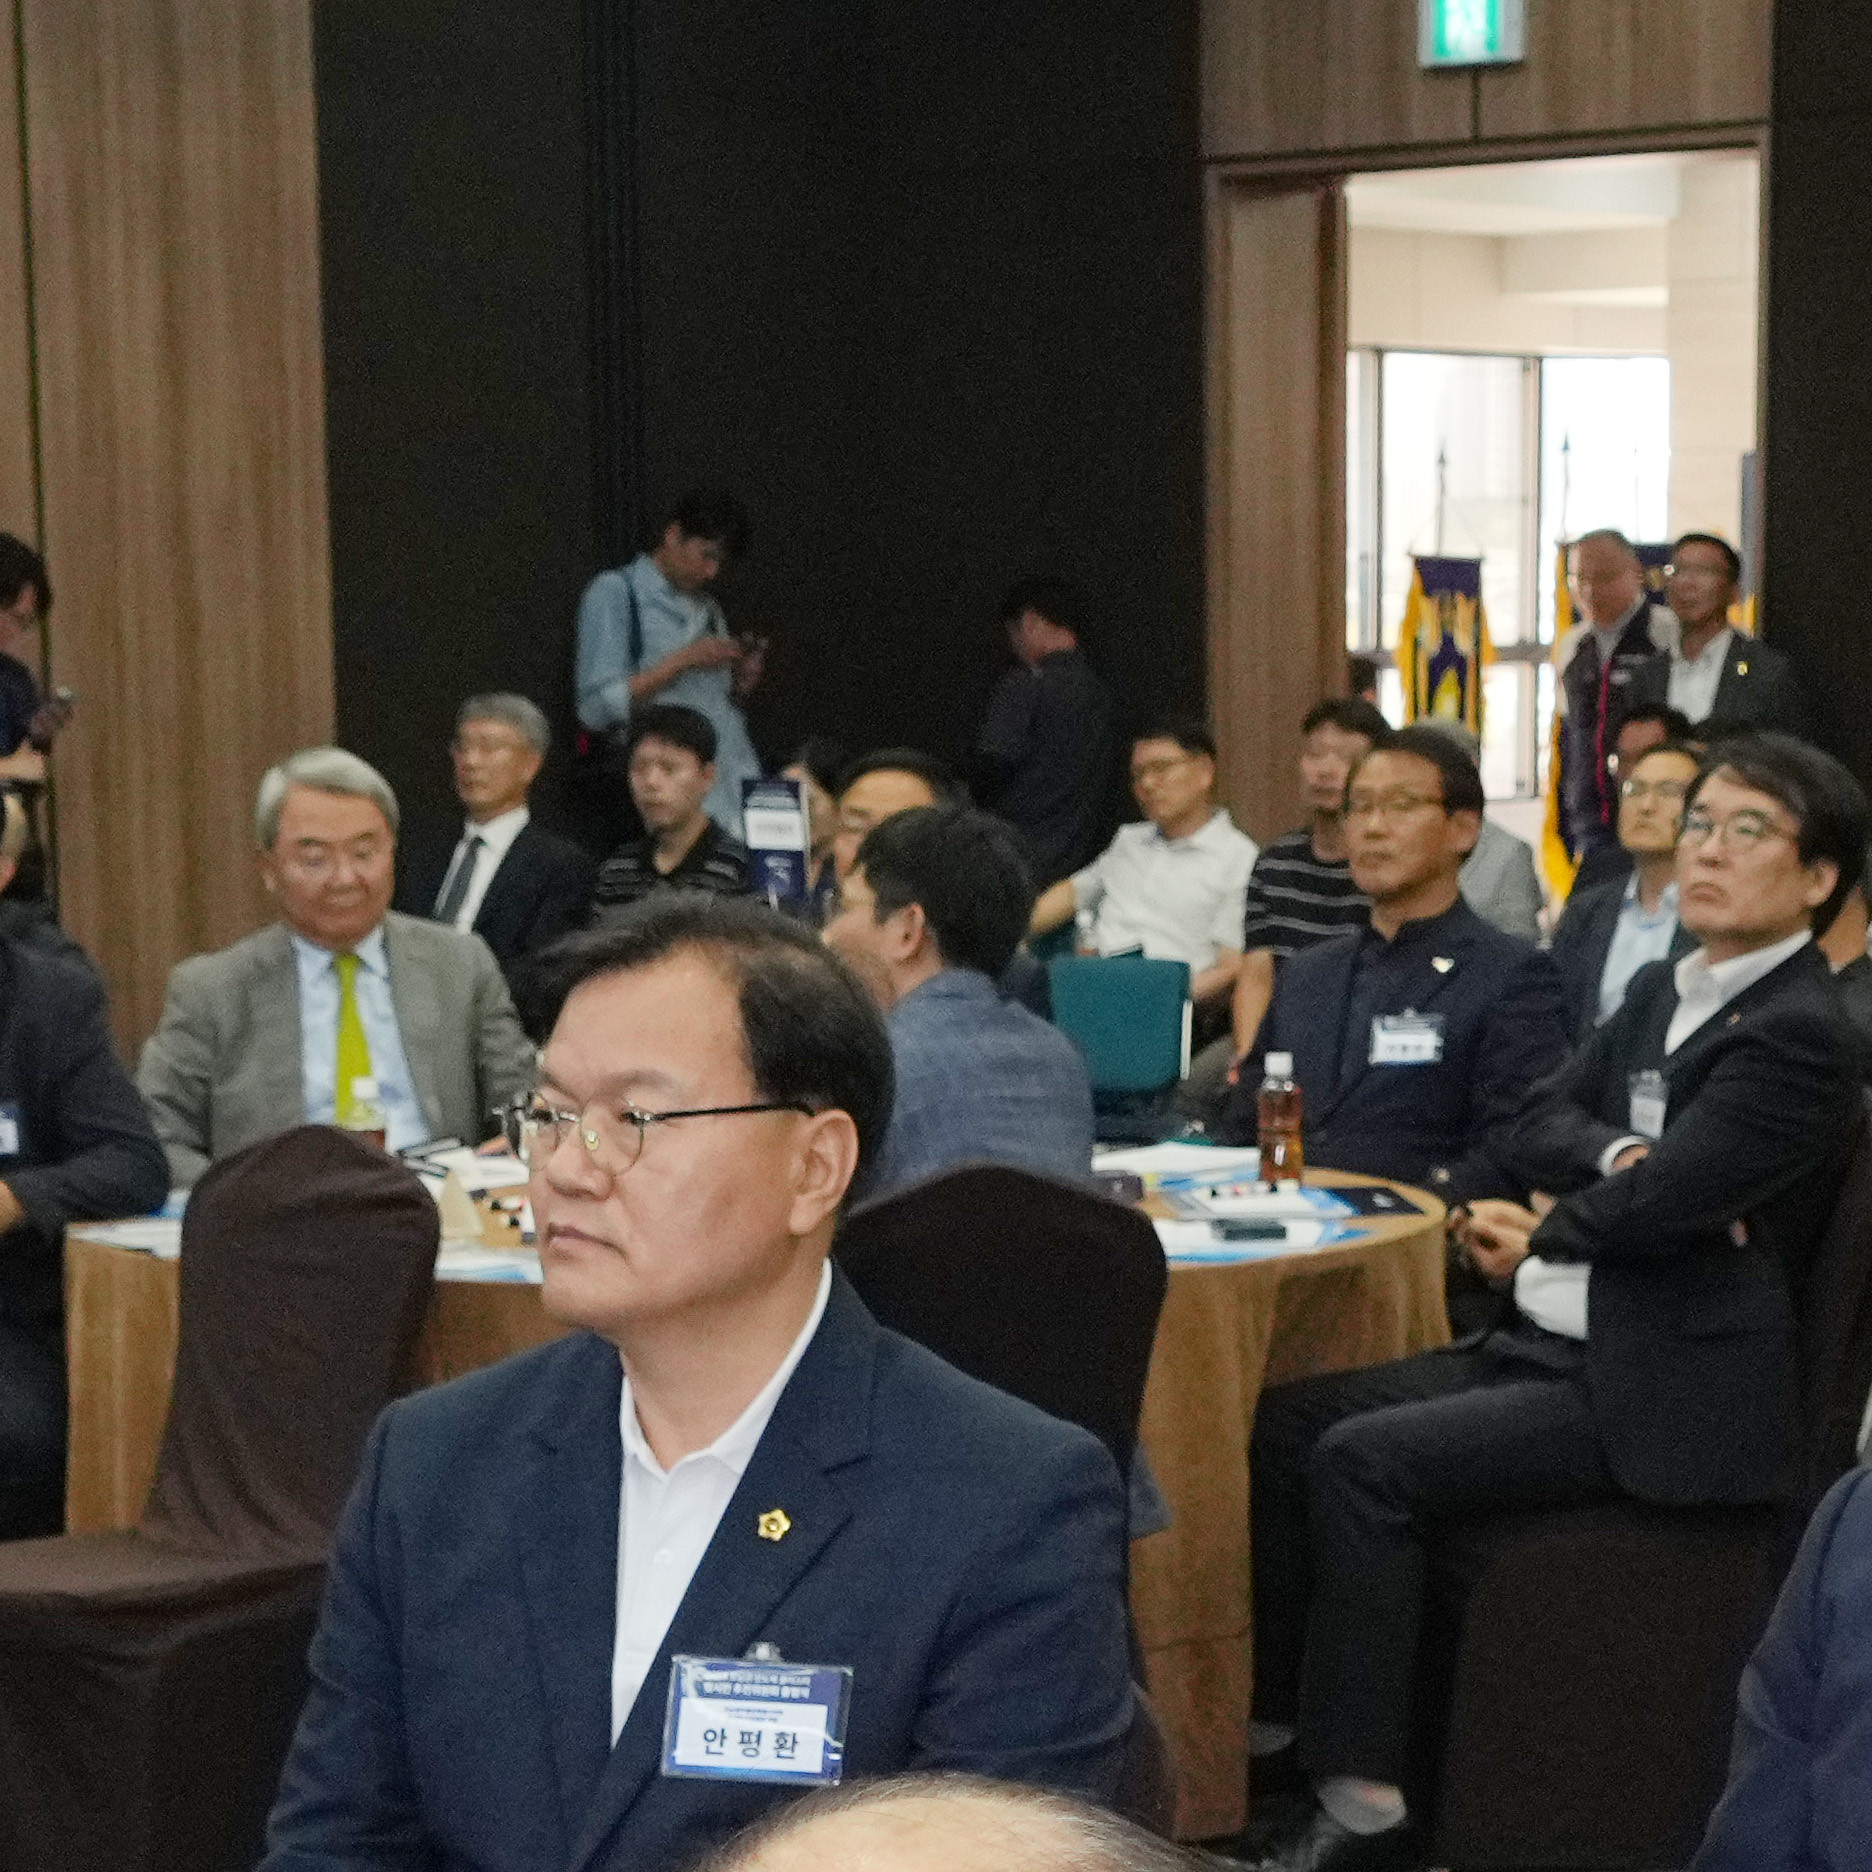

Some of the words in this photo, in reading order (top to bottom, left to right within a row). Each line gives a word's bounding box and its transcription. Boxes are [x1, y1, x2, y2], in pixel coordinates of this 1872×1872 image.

[704, 1728, 728, 1756] 안
[738, 1730, 762, 1758] 평
[773, 1731, 799, 1760] 환
